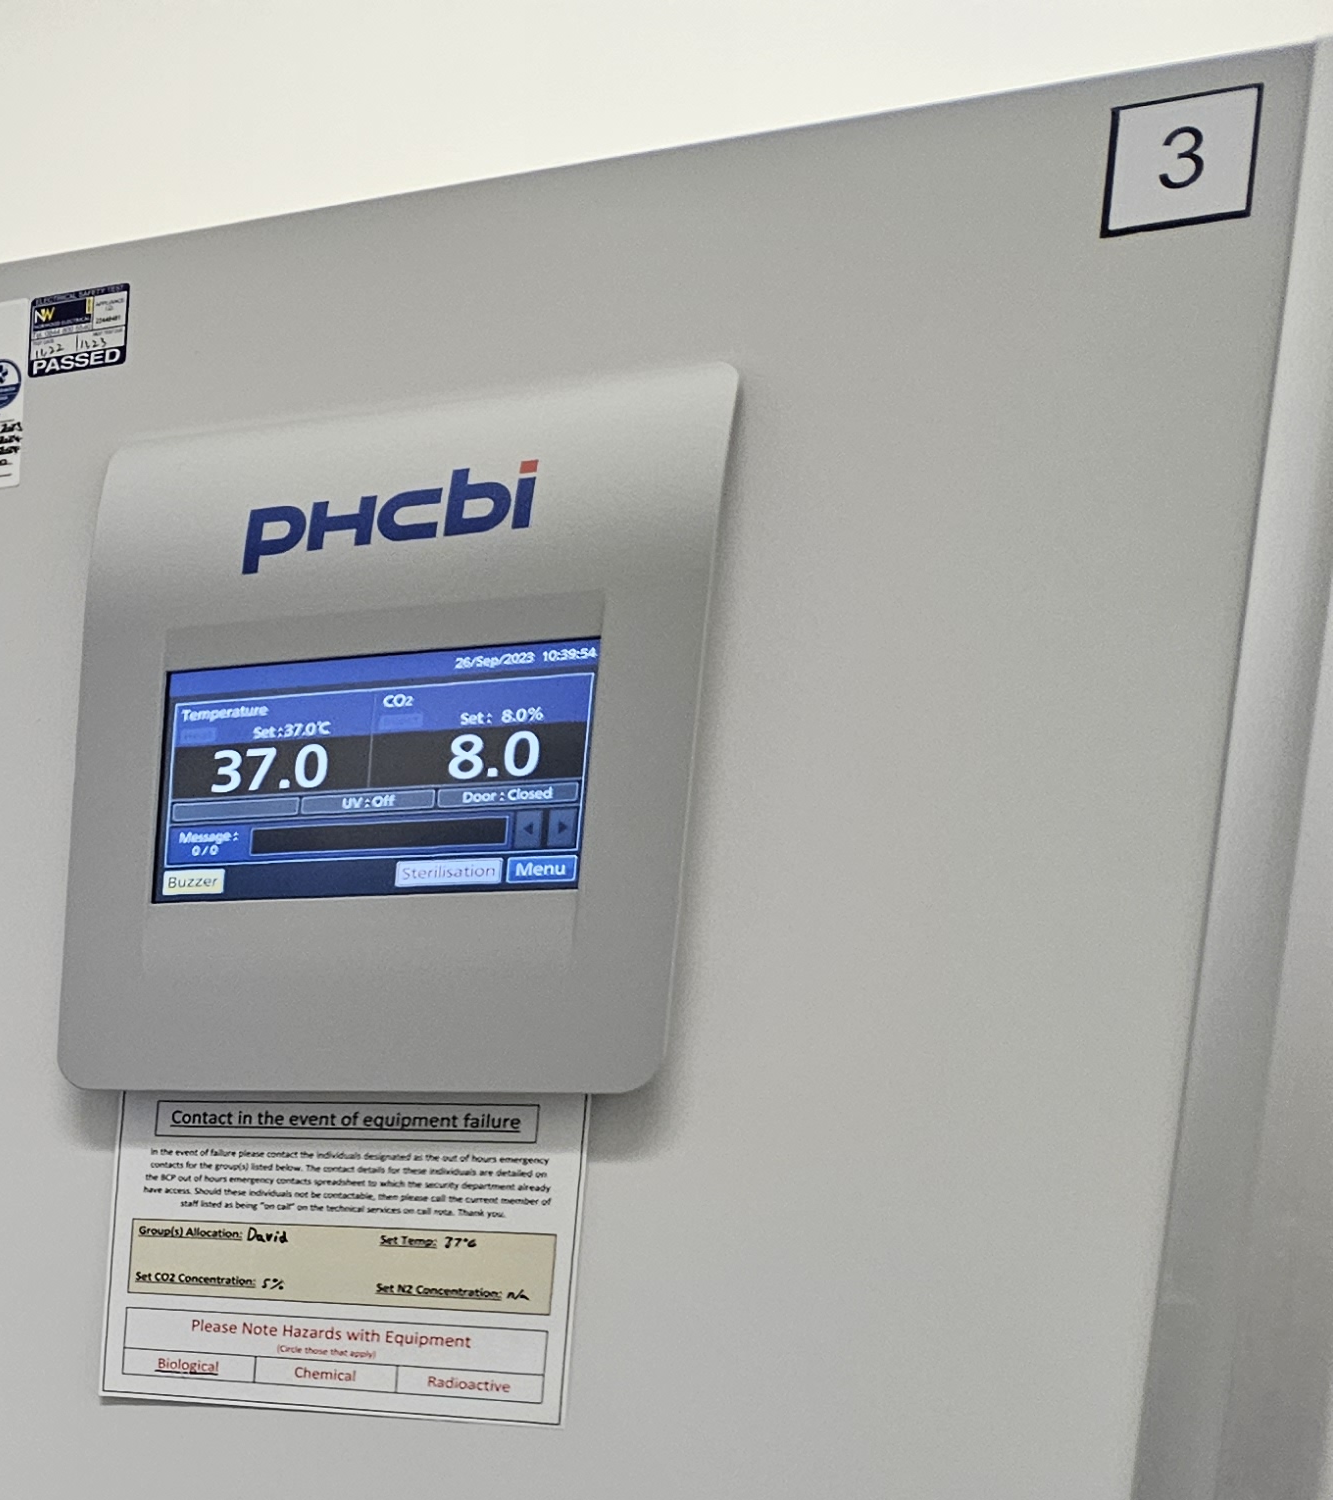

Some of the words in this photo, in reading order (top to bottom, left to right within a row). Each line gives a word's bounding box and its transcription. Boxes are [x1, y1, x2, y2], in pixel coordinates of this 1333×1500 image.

[1159, 126, 1204, 189] 3
[79, 289, 106, 297] SAFETY
[33, 348, 120, 375] PASSED
[454, 651, 535, 670] 26/Sep/2023
[542, 647, 598, 662] 10:39:54
[182, 705, 269, 722] Temperature
[501, 707, 544, 723] 8.0%
[448, 730, 540, 781] 8.0
[210, 743, 329, 794] 37.0
[401, 864, 496, 880] Sterilisation
[515, 861, 567, 878] Menu
[167, 876, 219, 889] Buzzer
[171, 1109, 233, 1126] Contact
[237, 1110, 253, 1126] in
[257, 1110, 284, 1126] the
[288, 1112, 336, 1127] event
[340, 1111, 359, 1128] of
[363, 1112, 458, 1131] equipment
[463, 1113, 522, 1130] failure
[160, 1148, 173, 1156] the
[175, 1149, 199, 1157] event
[199, 1149, 210, 1157] of
[210, 1149, 236, 1158] failure
[238, 1150, 265, 1160] please
[266, 1150, 299, 1159] contact
[300, 1151, 315, 1159] the
[316, 1151, 362, 1160] individuals
[363, 1152, 412, 1162] designated
[426, 1153, 441, 1162] the
[442, 1154, 458, 1162] out
[459, 1154, 470, 1163] of
[471, 1154, 497, 1164] hours
[499, 1156, 550, 1167] emergency
[150, 1161, 184, 1170] contacts
[185, 1161, 198, 1170] for
[199, 1162, 213, 1170] the
[251, 1163, 274, 1172] listed
[305, 1164, 321, 1173] The
[323, 1165, 355, 1174] contact
[357, 1166, 385, 1174] details
[387, 1166, 401, 1175] for
[402, 1167, 427, 1175] these
[429, 1167, 478, 1176] individuals
[479, 1169, 494, 1177] are
[495, 1169, 533, 1178] detailed
[138, 1225, 184, 1238] Group(s)
[185, 1226, 243, 1239] Allocation:
[247, 1226, 289, 1244] David
[380, 1235, 399, 1246] Set
[401, 1236, 437, 1248] Temp:
[135, 1271, 153, 1282] Set
[154, 1272, 175, 1283] CO2
[177, 1273, 256, 1287] Concentration:
[376, 1283, 395, 1294] Set
[397, 1284, 413, 1294] N2
[415, 1285, 502, 1299] Concentration:
[191, 1319, 238, 1335] Please
[242, 1321, 278, 1337] Note
[282, 1324, 342, 1341] Hazards
[346, 1328, 380, 1343] with
[385, 1330, 472, 1349] Equipment
[276, 1344, 302, 1356] (Circle
[304, 1346, 328, 1356] those
[330, 1347, 348, 1358] that
[349, 1349, 377, 1360] apply)
[157, 1357, 219, 1373] Biological
[294, 1367, 357, 1382] Chemical
[427, 1376, 511, 1393] Radioactive
